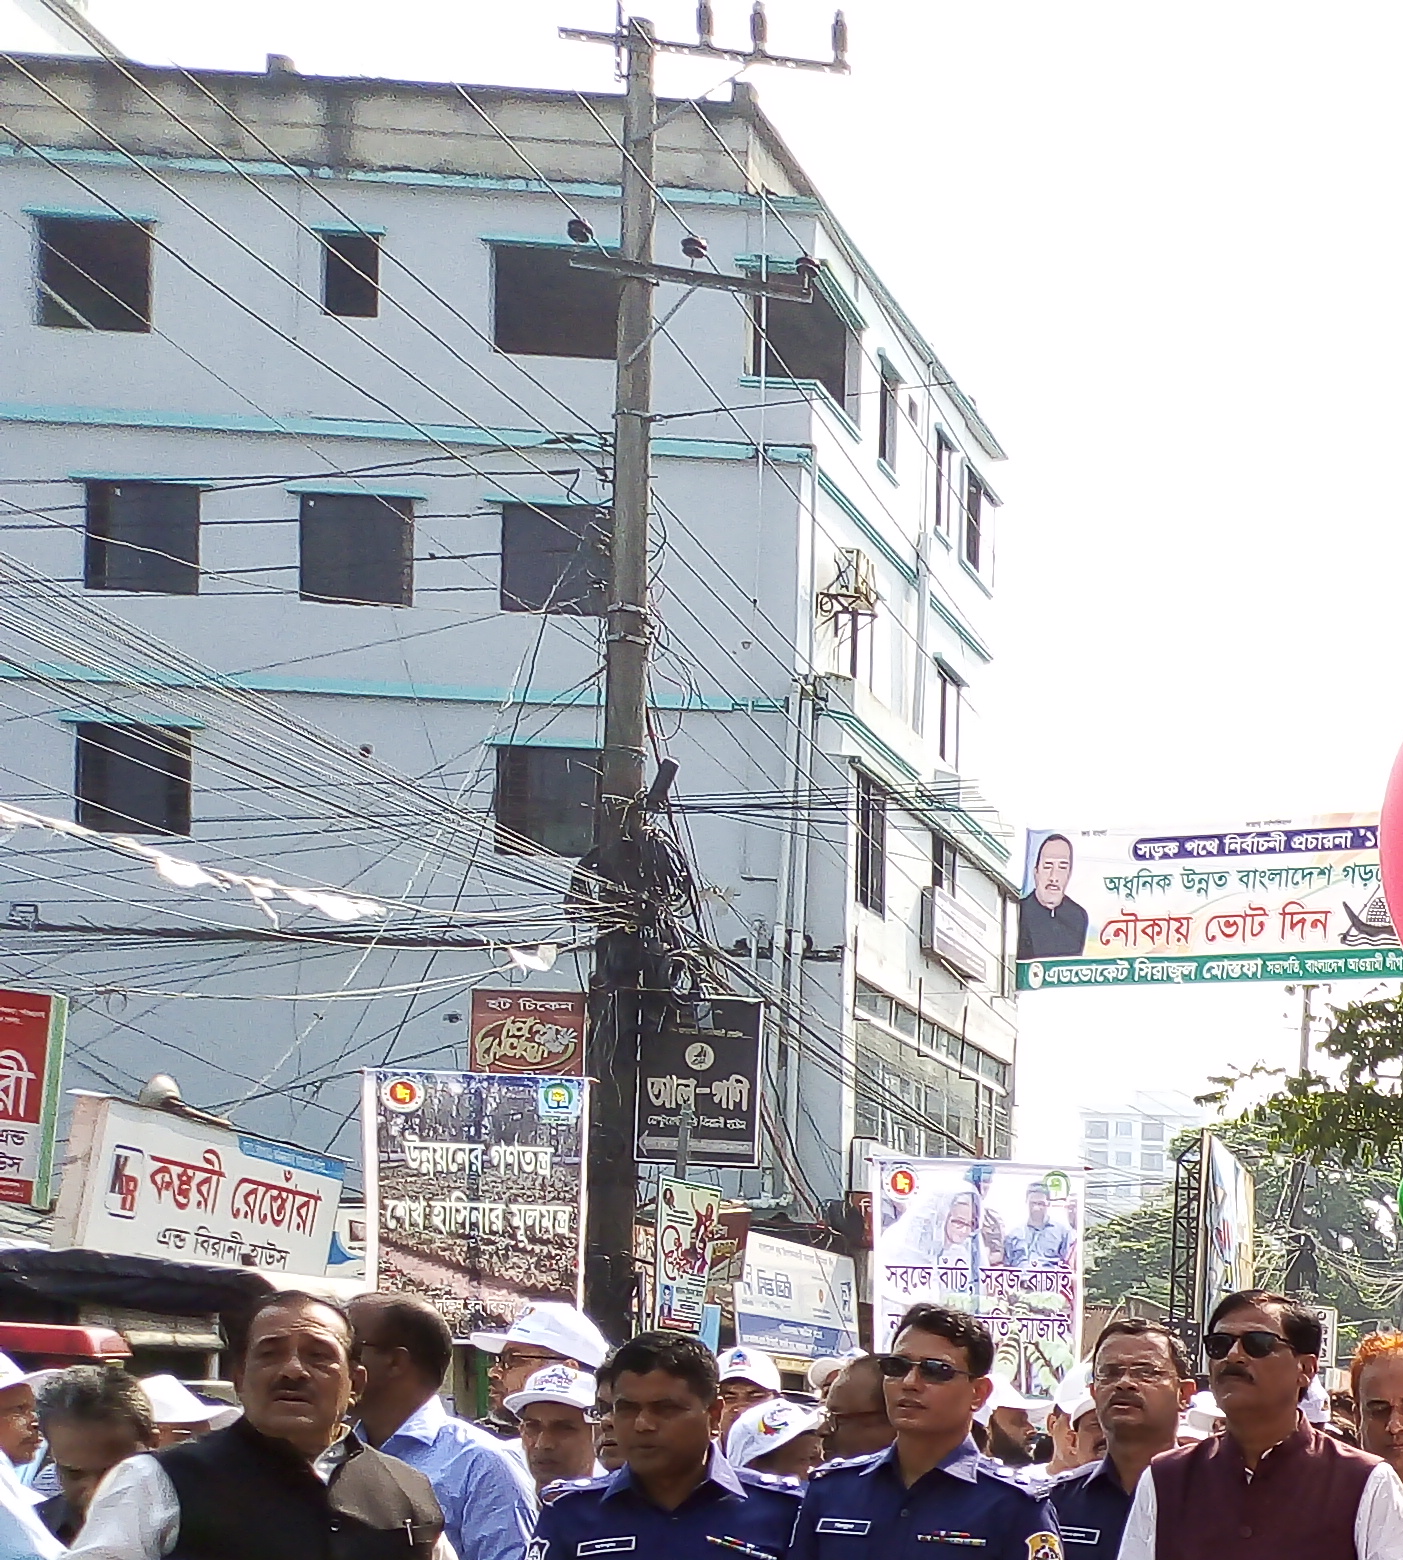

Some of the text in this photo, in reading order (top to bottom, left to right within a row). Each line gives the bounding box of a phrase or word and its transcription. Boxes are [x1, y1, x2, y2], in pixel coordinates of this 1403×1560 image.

[1180, 866, 1230, 900] উন্নত
[1237, 863, 1333, 891] বাংলাদেশ
[1099, 900, 1333, 947] নৌকায় ভোট দিন
[429, 1191, 507, 1237] হাসিনার
